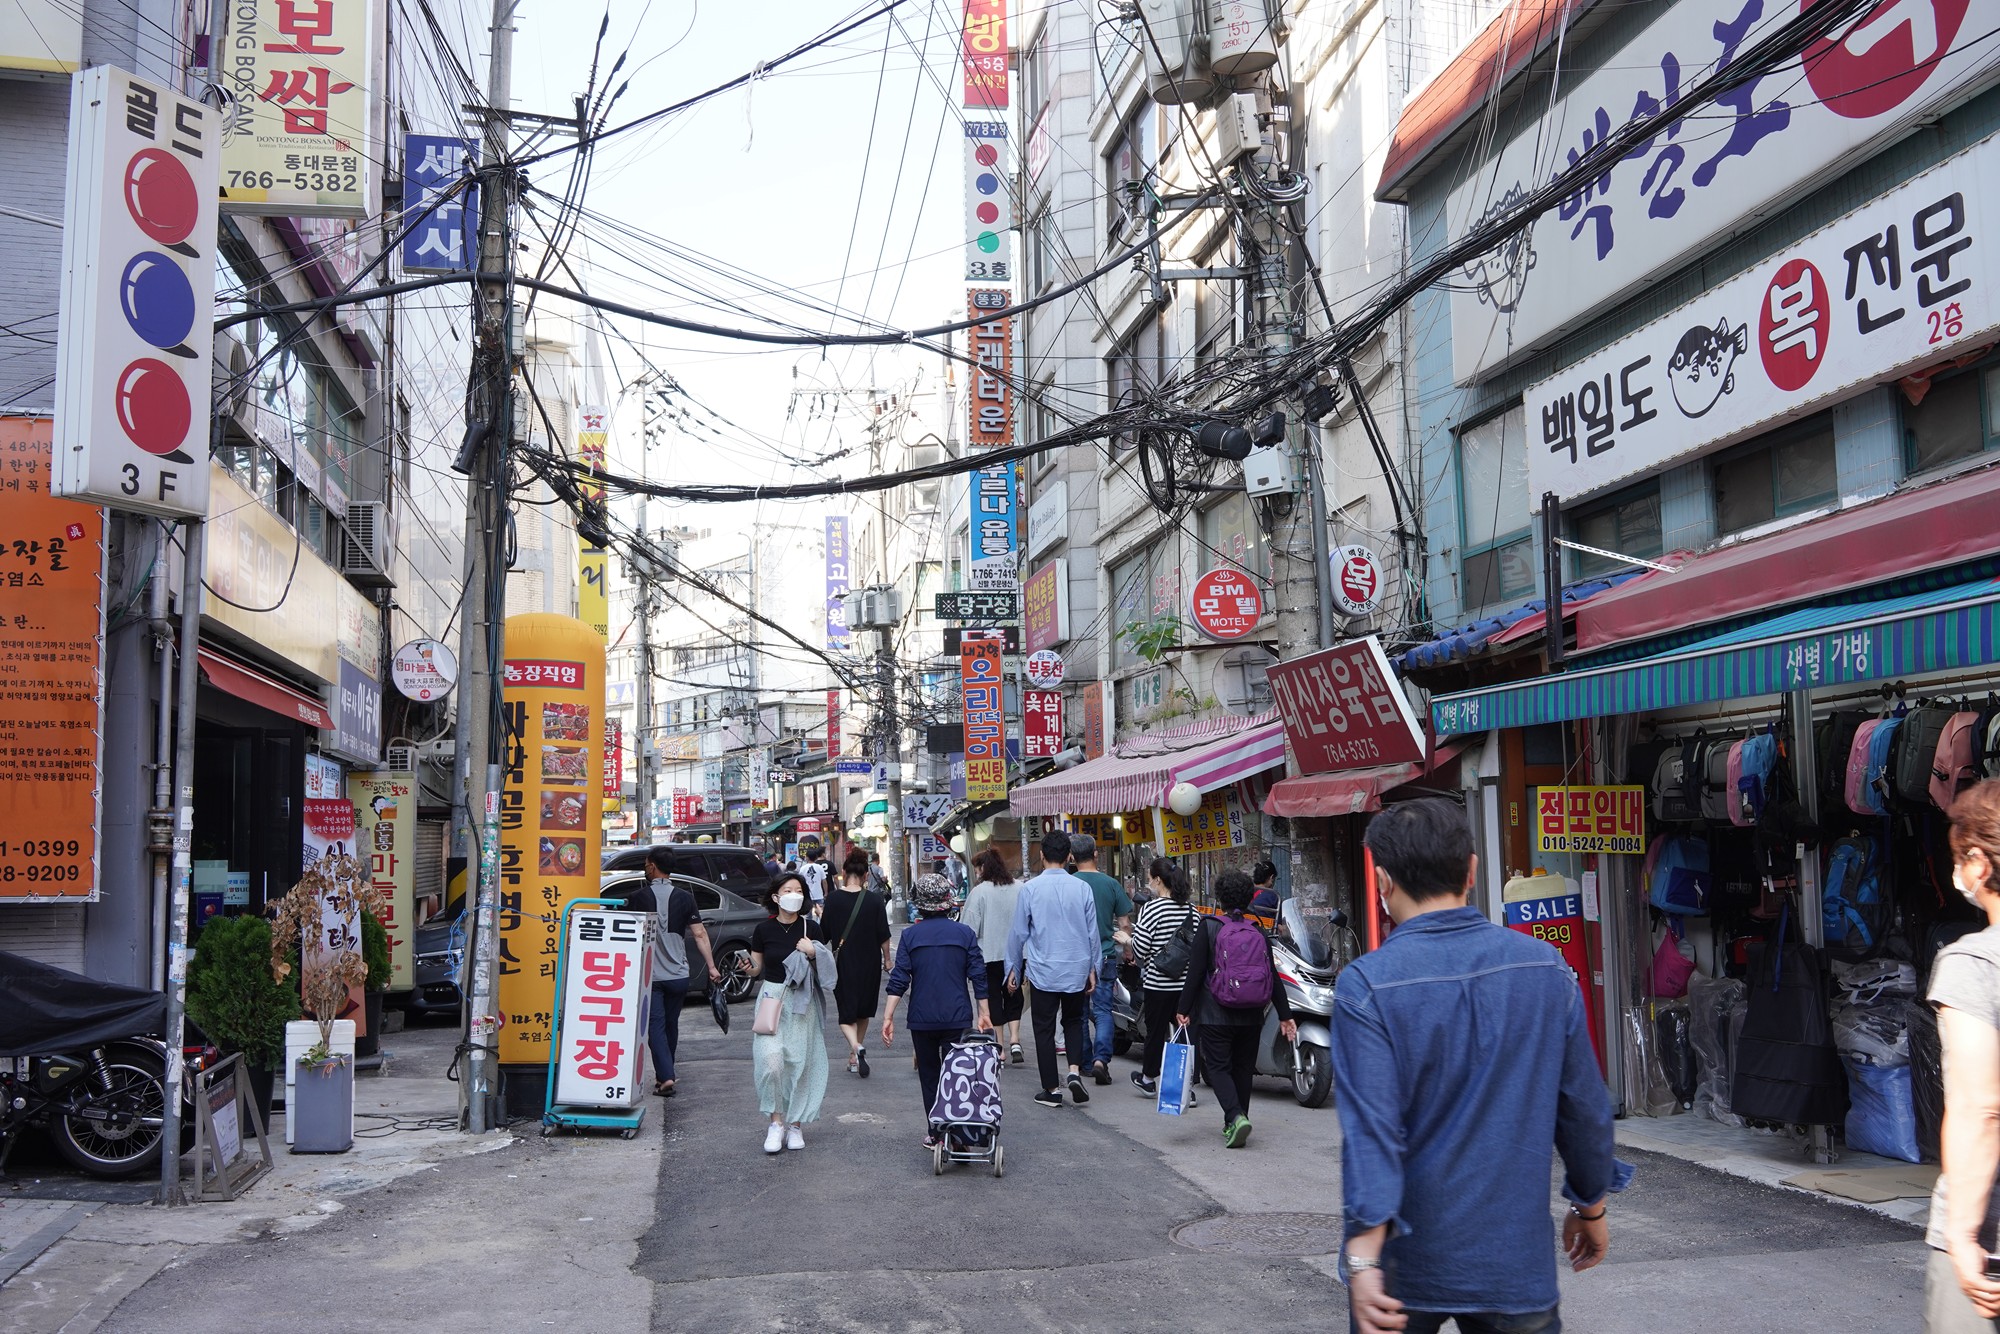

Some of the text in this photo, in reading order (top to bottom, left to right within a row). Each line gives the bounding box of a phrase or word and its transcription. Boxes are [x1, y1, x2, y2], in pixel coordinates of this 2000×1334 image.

[257, 0, 346, 135] 보쌈
[967, 56, 1005, 71] 4-5층
[966, 74, 1006, 89] 24시간
[234, 56, 256, 136] BOSSAM
[126, 81, 204, 160] 골드
[256, 136, 335, 146] DONTONG BOSSAM
[284, 154, 358, 171] 동대문점
[227, 170, 358, 192] 766-5382
[970, 261, 1007, 276] 3층
[1541, 191, 1973, 465] 백일도 복 전문
[1927, 302, 1965, 346] 2층
[10, 460, 38, 473] 한방
[0, 571, 45, 588] 염소
[972, 569, 1017, 579] T.766-7419
[1344, 559, 1373, 600] 복
[1026, 570, 1055, 617] 성인용품
[1209, 584, 1244, 596] BM
[957, 596, 1011, 616] 당구장
[1199, 597, 1258, 616] 모텔
[1209, 617, 1249, 627] MOTEL
[26, 641, 66, 650] 이르기까지
[69, 642, 92, 650] 신비의
[962, 642, 999, 659] 내고향
[1037, 652, 1055, 660] 한국
[1785, 631, 1871, 685] 샛별 가방
[504, 664, 577, 684] 농장직영
[1029, 660, 1063, 678] 부동산
[10, 680, 53, 688] 이르기까지
[57, 681, 91, 689] 노약자나
[1271, 649, 1401, 740] 대신정육점
[1043, 693, 1060, 755] 삼계탕
[1441, 699, 1480, 731] 샛별 가방
[1322, 737, 1380, 765] 764-5375
[967, 762, 1005, 784] 보신탕
[907, 807, 926, 823] 블루
[1166, 811, 1225, 833] 소내장탕
[1539, 790, 1643, 836] 점포임대
[1182, 829, 1228, 851] 곱창볶음
[1542, 836, 1641, 852] 010-5242-0084
[0, 865, 80, 882] 8-9209
[1519, 897, 1577, 922] SALE
[578, 917, 638, 943] 골드
[1531, 923, 1572, 943] Bag
[573, 951, 632, 1081] 당구장
[605, 1086, 626, 1099] 3F
